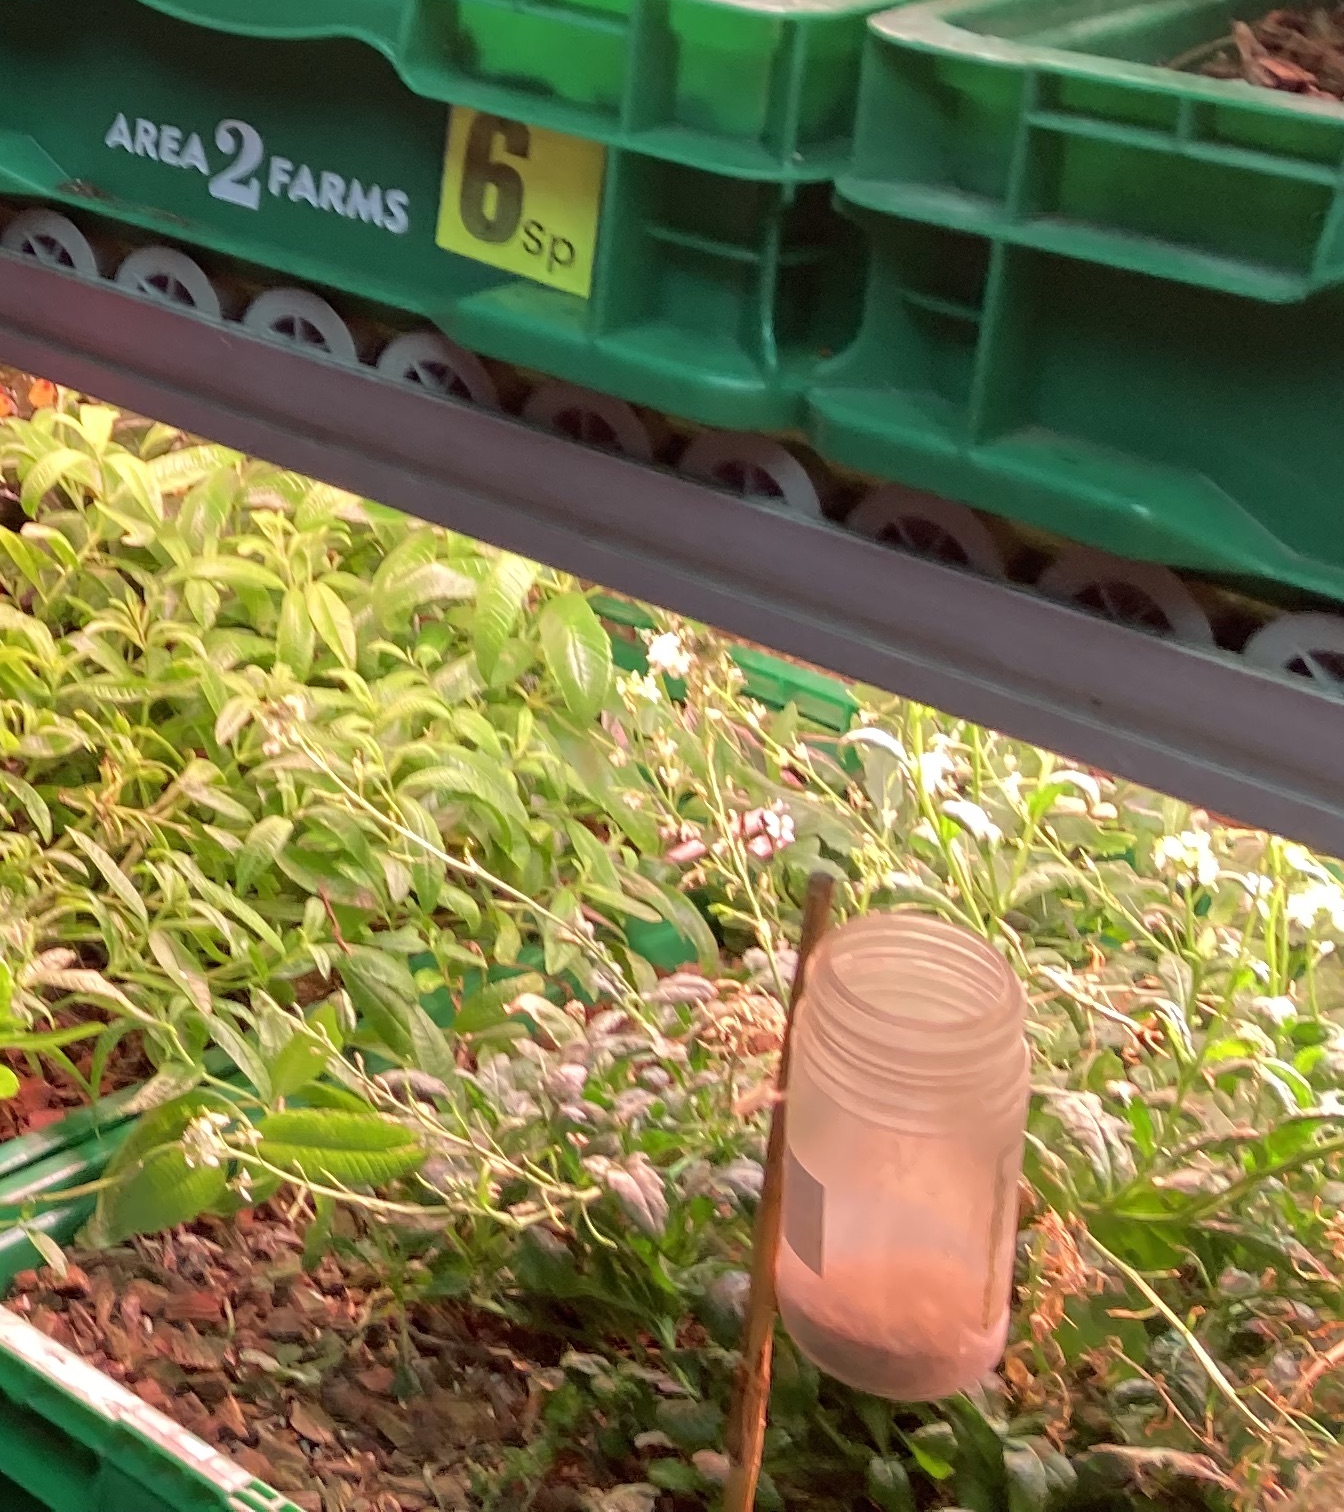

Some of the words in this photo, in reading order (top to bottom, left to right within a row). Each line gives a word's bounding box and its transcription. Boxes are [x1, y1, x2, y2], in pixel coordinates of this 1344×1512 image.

[105, 112, 210, 176] AREA
[209, 118, 264, 211] 2
[268, 155, 410, 234] FARMS
[458, 112, 531, 244] 6
